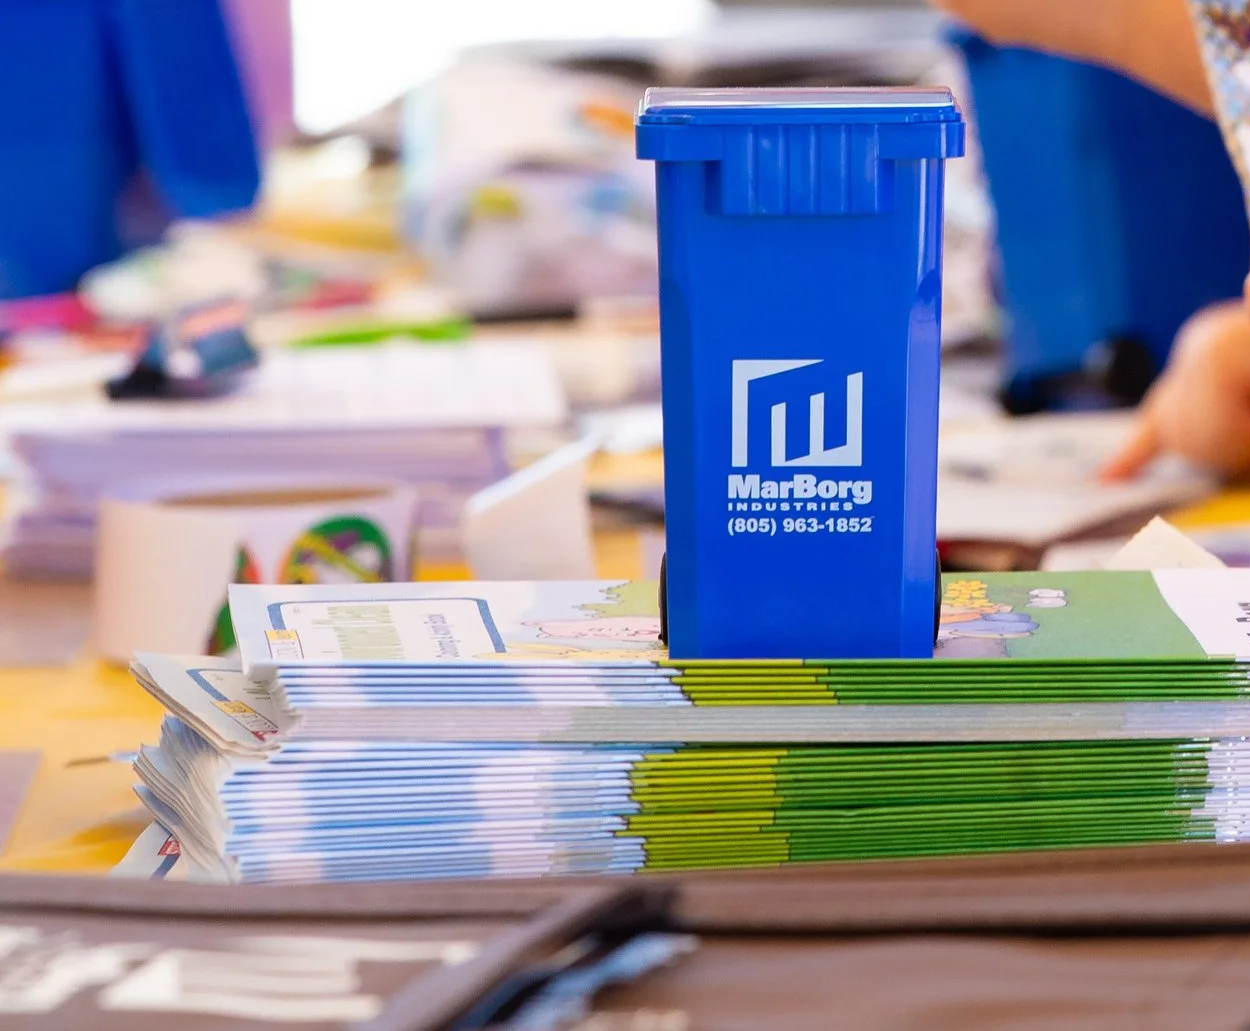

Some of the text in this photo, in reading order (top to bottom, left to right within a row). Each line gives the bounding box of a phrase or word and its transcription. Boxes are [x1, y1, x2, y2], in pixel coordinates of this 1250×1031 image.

[727, 474, 873, 505] MarBorg
[728, 502, 853, 511] INDUSTRIES
[727, 517, 874, 536] (805) 963-1852
